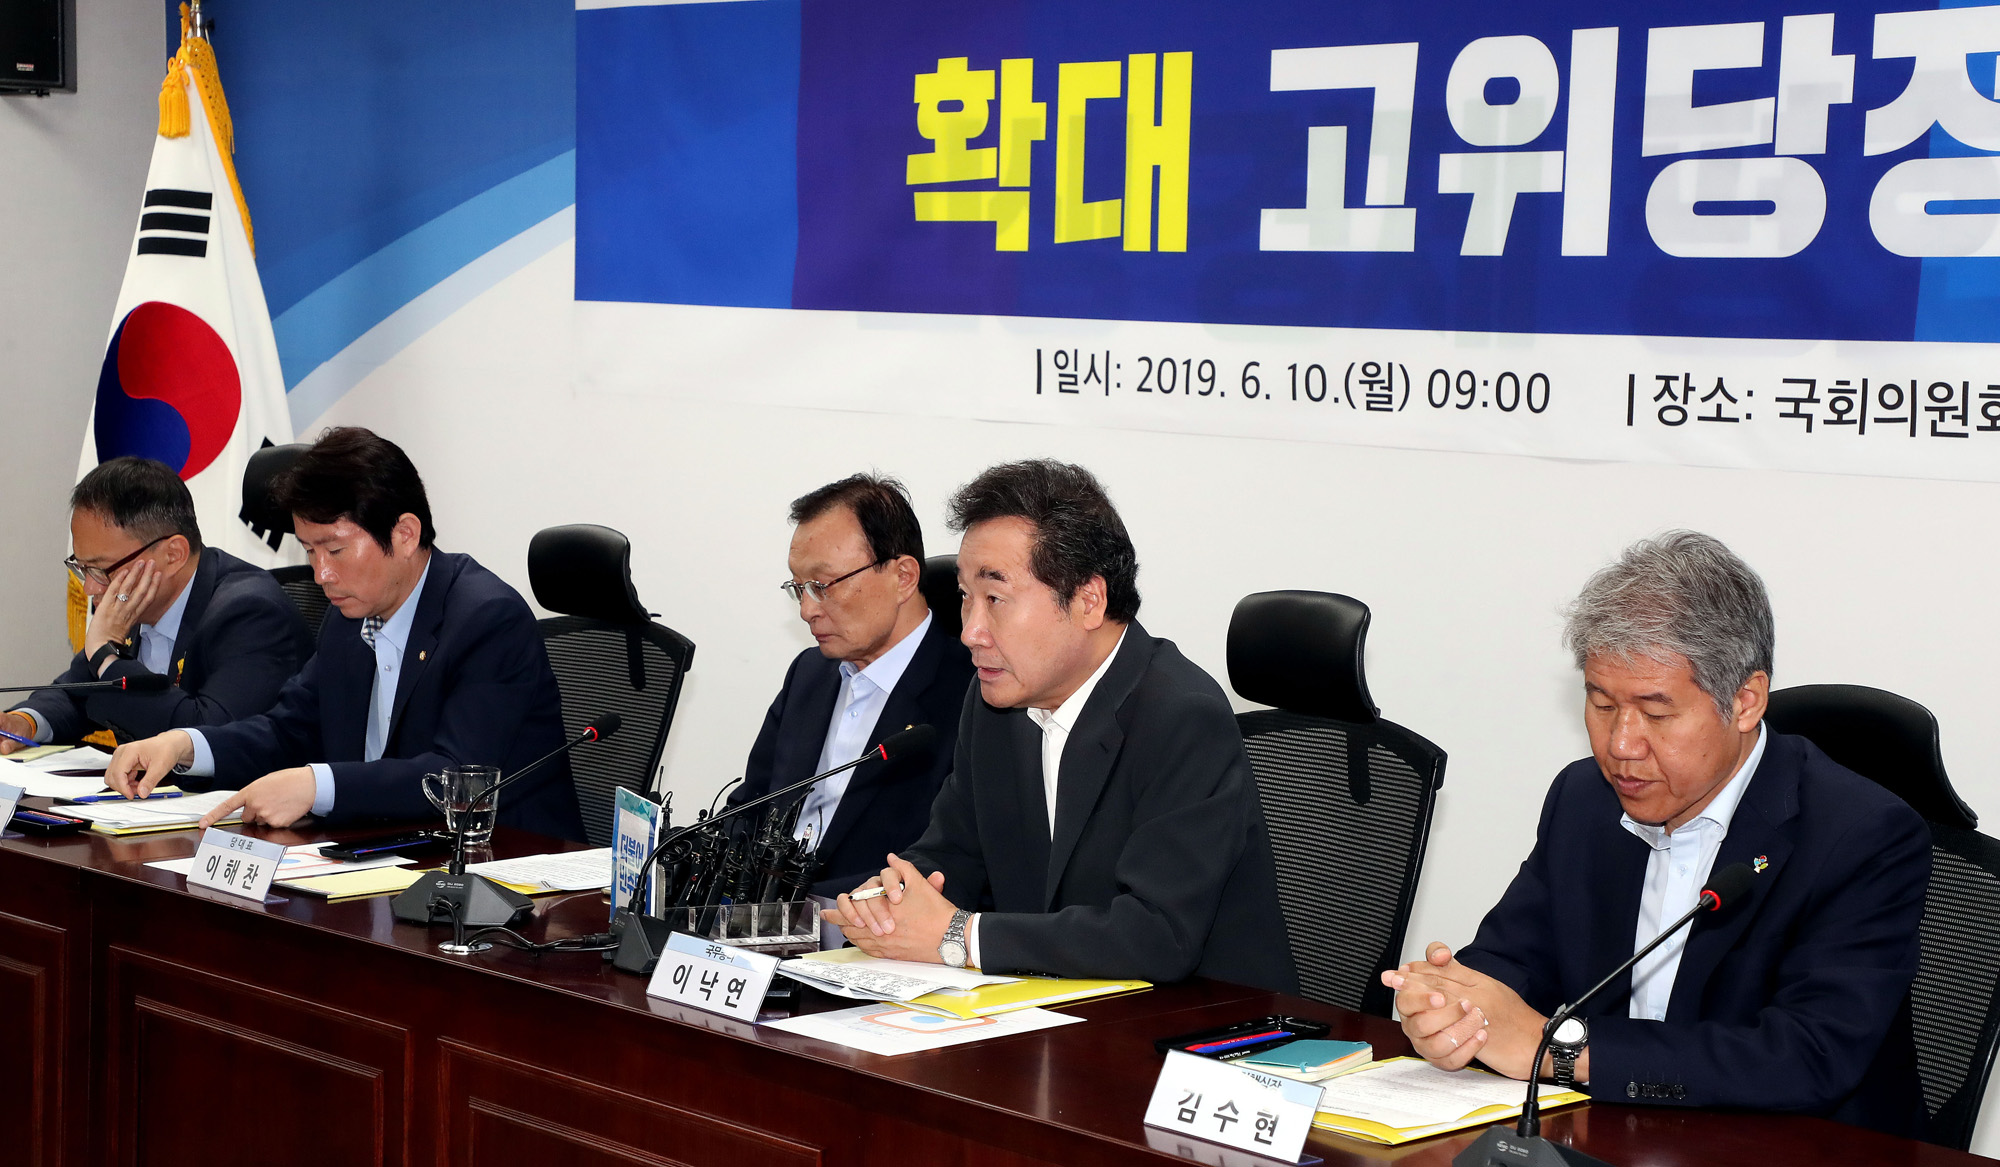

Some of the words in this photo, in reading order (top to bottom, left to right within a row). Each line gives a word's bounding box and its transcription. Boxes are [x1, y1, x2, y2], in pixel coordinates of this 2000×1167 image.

[906, 52, 1192, 252] 확대
[1052, 348, 1122, 397] 일시:
[1136, 356, 1226, 398] 2019.
[1241, 361, 1271, 400] 6.
[1287, 361, 1411, 413] 10.(월)
[1427, 368, 1551, 414] 09:00
[1652, 373, 1754, 427] 장소:
[229, 836, 254, 851] 당대표
[206, 854, 260, 890] 이해찬
[619, 863, 641, 896] 민주
[672, 964, 747, 1009] 이낙연
